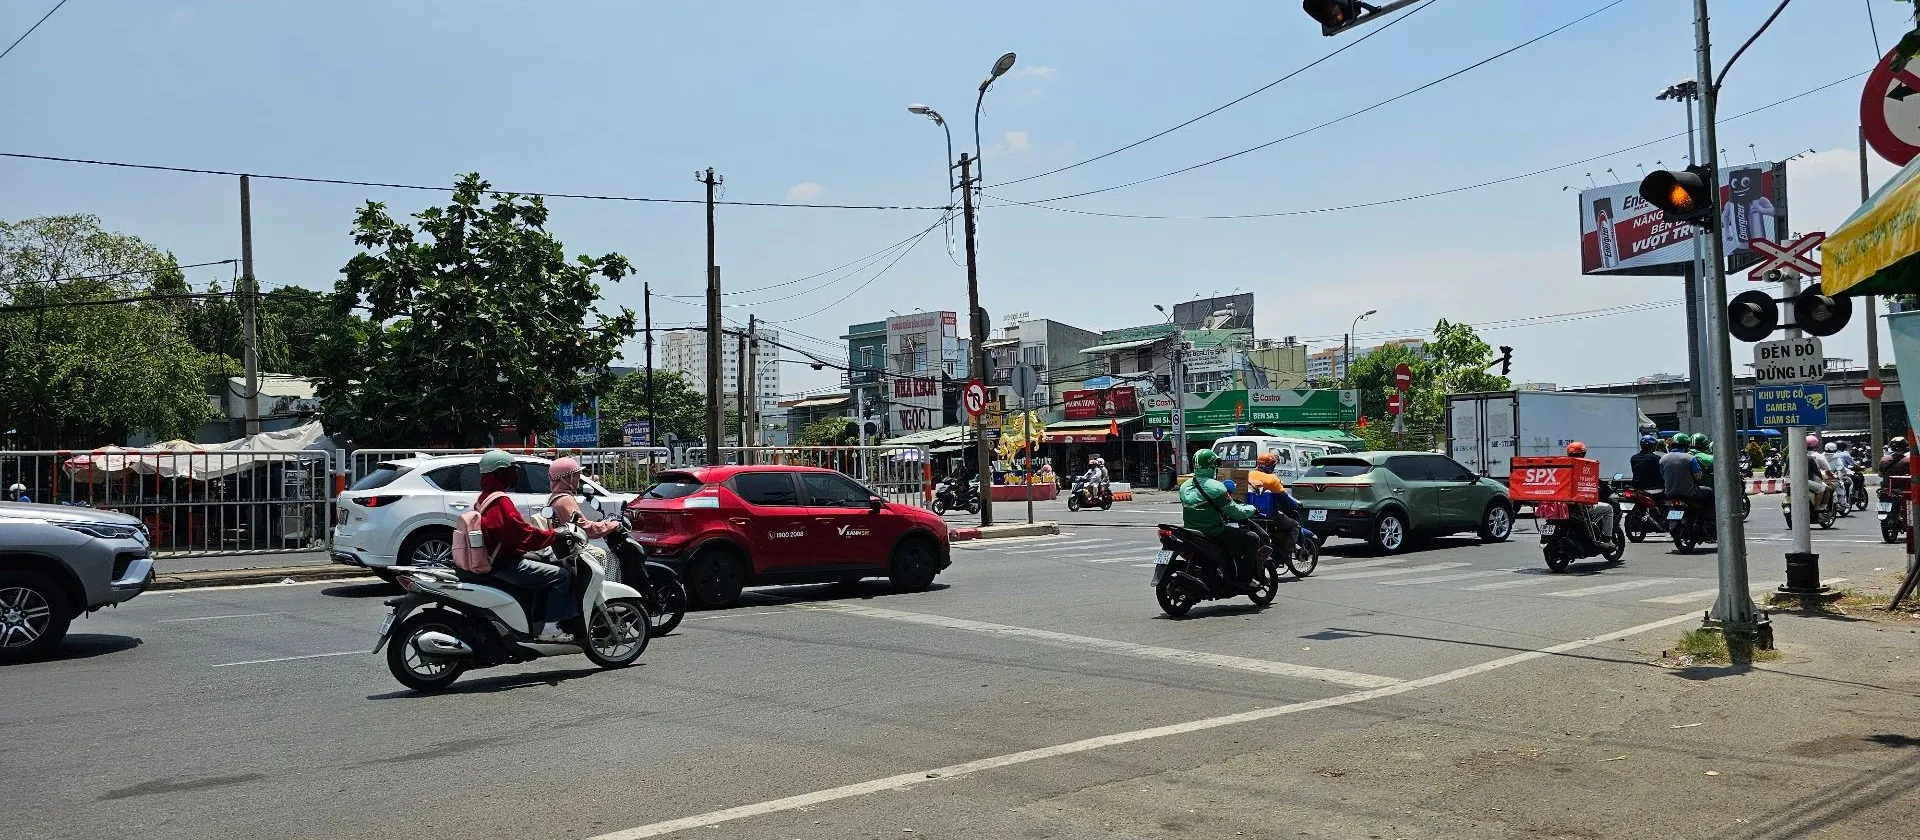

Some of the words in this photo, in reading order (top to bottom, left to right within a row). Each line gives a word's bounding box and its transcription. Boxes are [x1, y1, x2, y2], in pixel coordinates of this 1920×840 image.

[1737, 203, 1749, 241] Energizer
[1761, 343, 1790, 359] ĐÈN
[1794, 339, 1815, 356] ĐỎ
[1756, 365, 1795, 380] DỪNG
[1800, 364, 1823, 380] LẠI
[1260, 394, 1281, 402] Castrol
[1758, 391, 1774, 400] KHU
[1775, 389, 1791, 401] VỰC
[1793, 387, 1804, 398] CÓ
[1765, 402, 1797, 412] CAMERA
[1148, 416, 1161, 424] BEN
[1253, 412, 1265, 420] BEN
[1266, 412, 1275, 420] SA
[1763, 414, 1784, 425] GIÁM
[1785, 413, 1800, 424] SÁT
[1525, 468, 1559, 485] SPX
